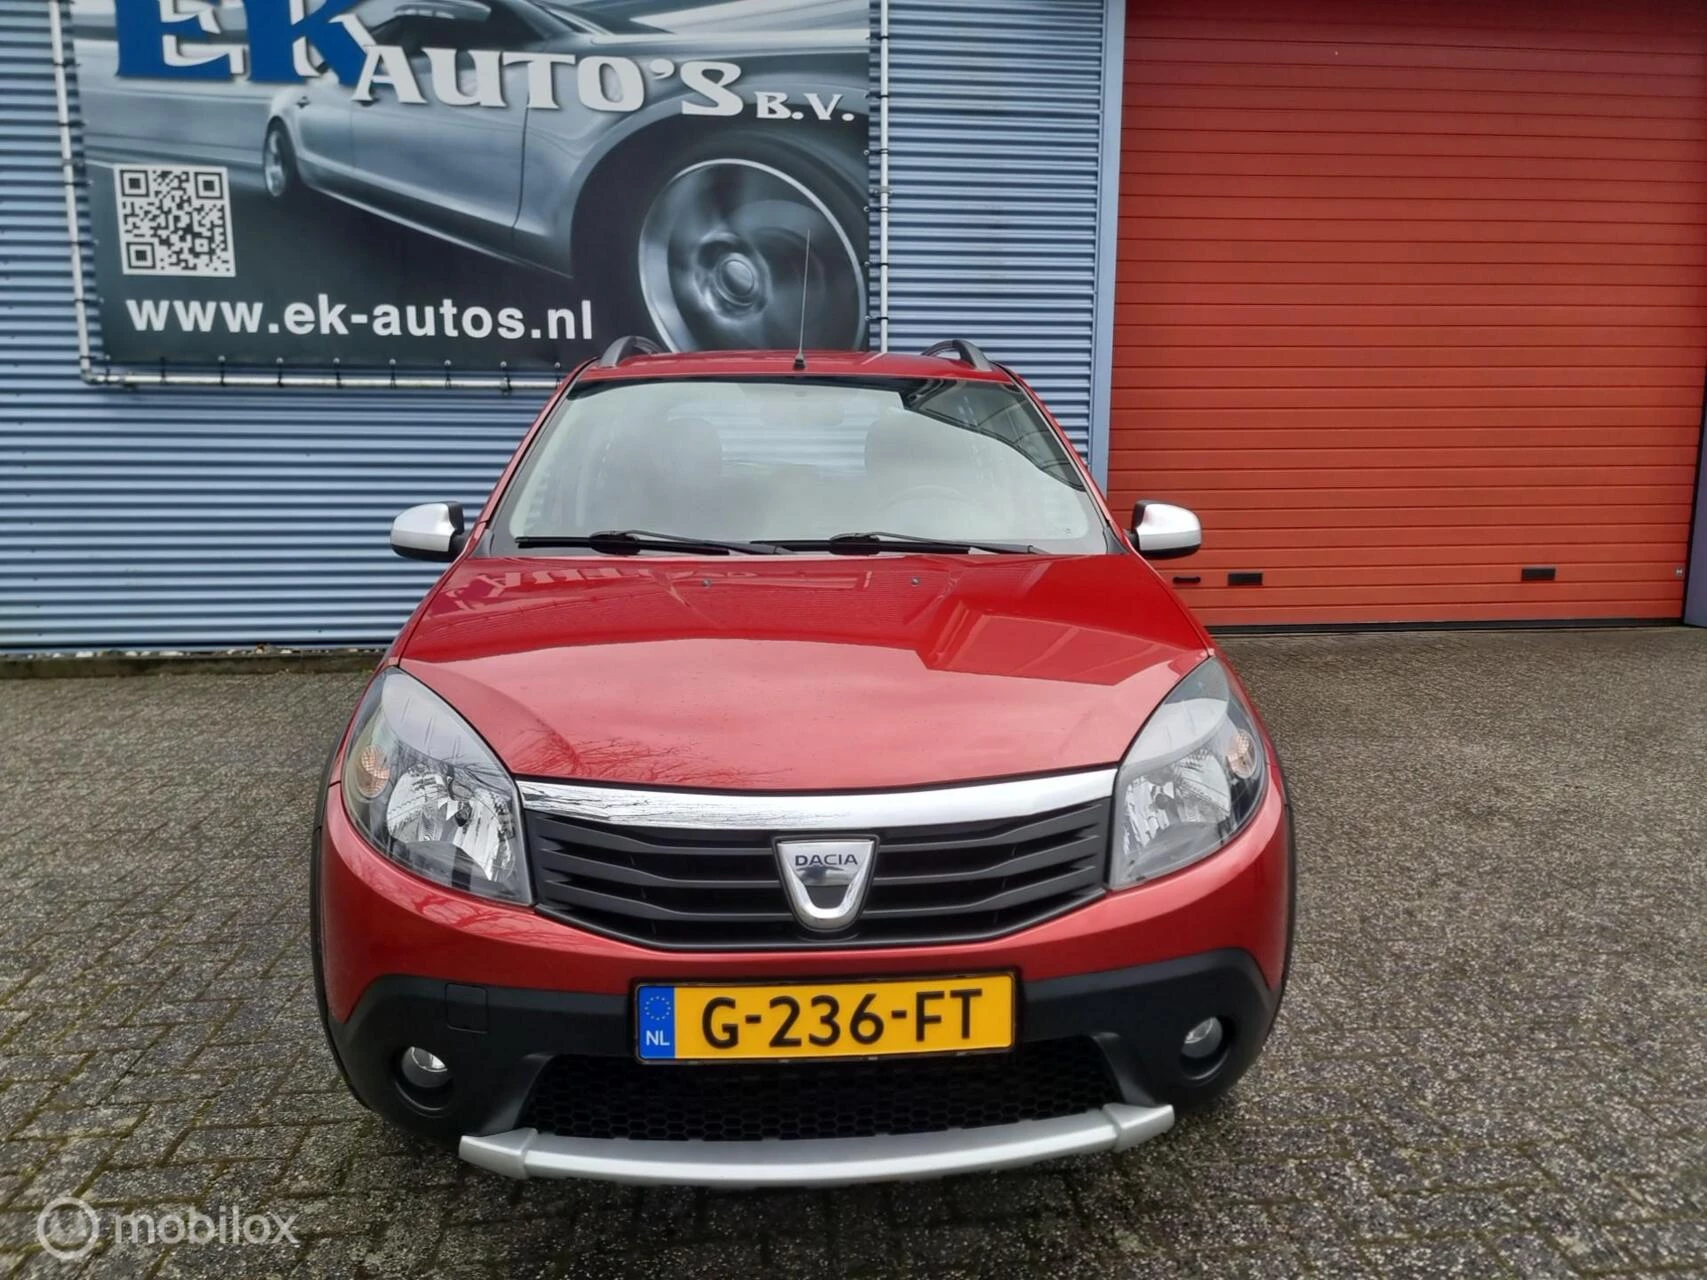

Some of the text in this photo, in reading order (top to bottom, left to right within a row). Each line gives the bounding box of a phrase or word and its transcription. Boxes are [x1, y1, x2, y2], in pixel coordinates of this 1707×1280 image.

[754, 90, 856, 122] B.V.
[126, 293, 593, 341] www.ek-autos.nl
[795, 853, 858, 867] DACIA
[701, 988, 983, 1049] G-236-FT
[645, 1030, 670, 1047] NL
